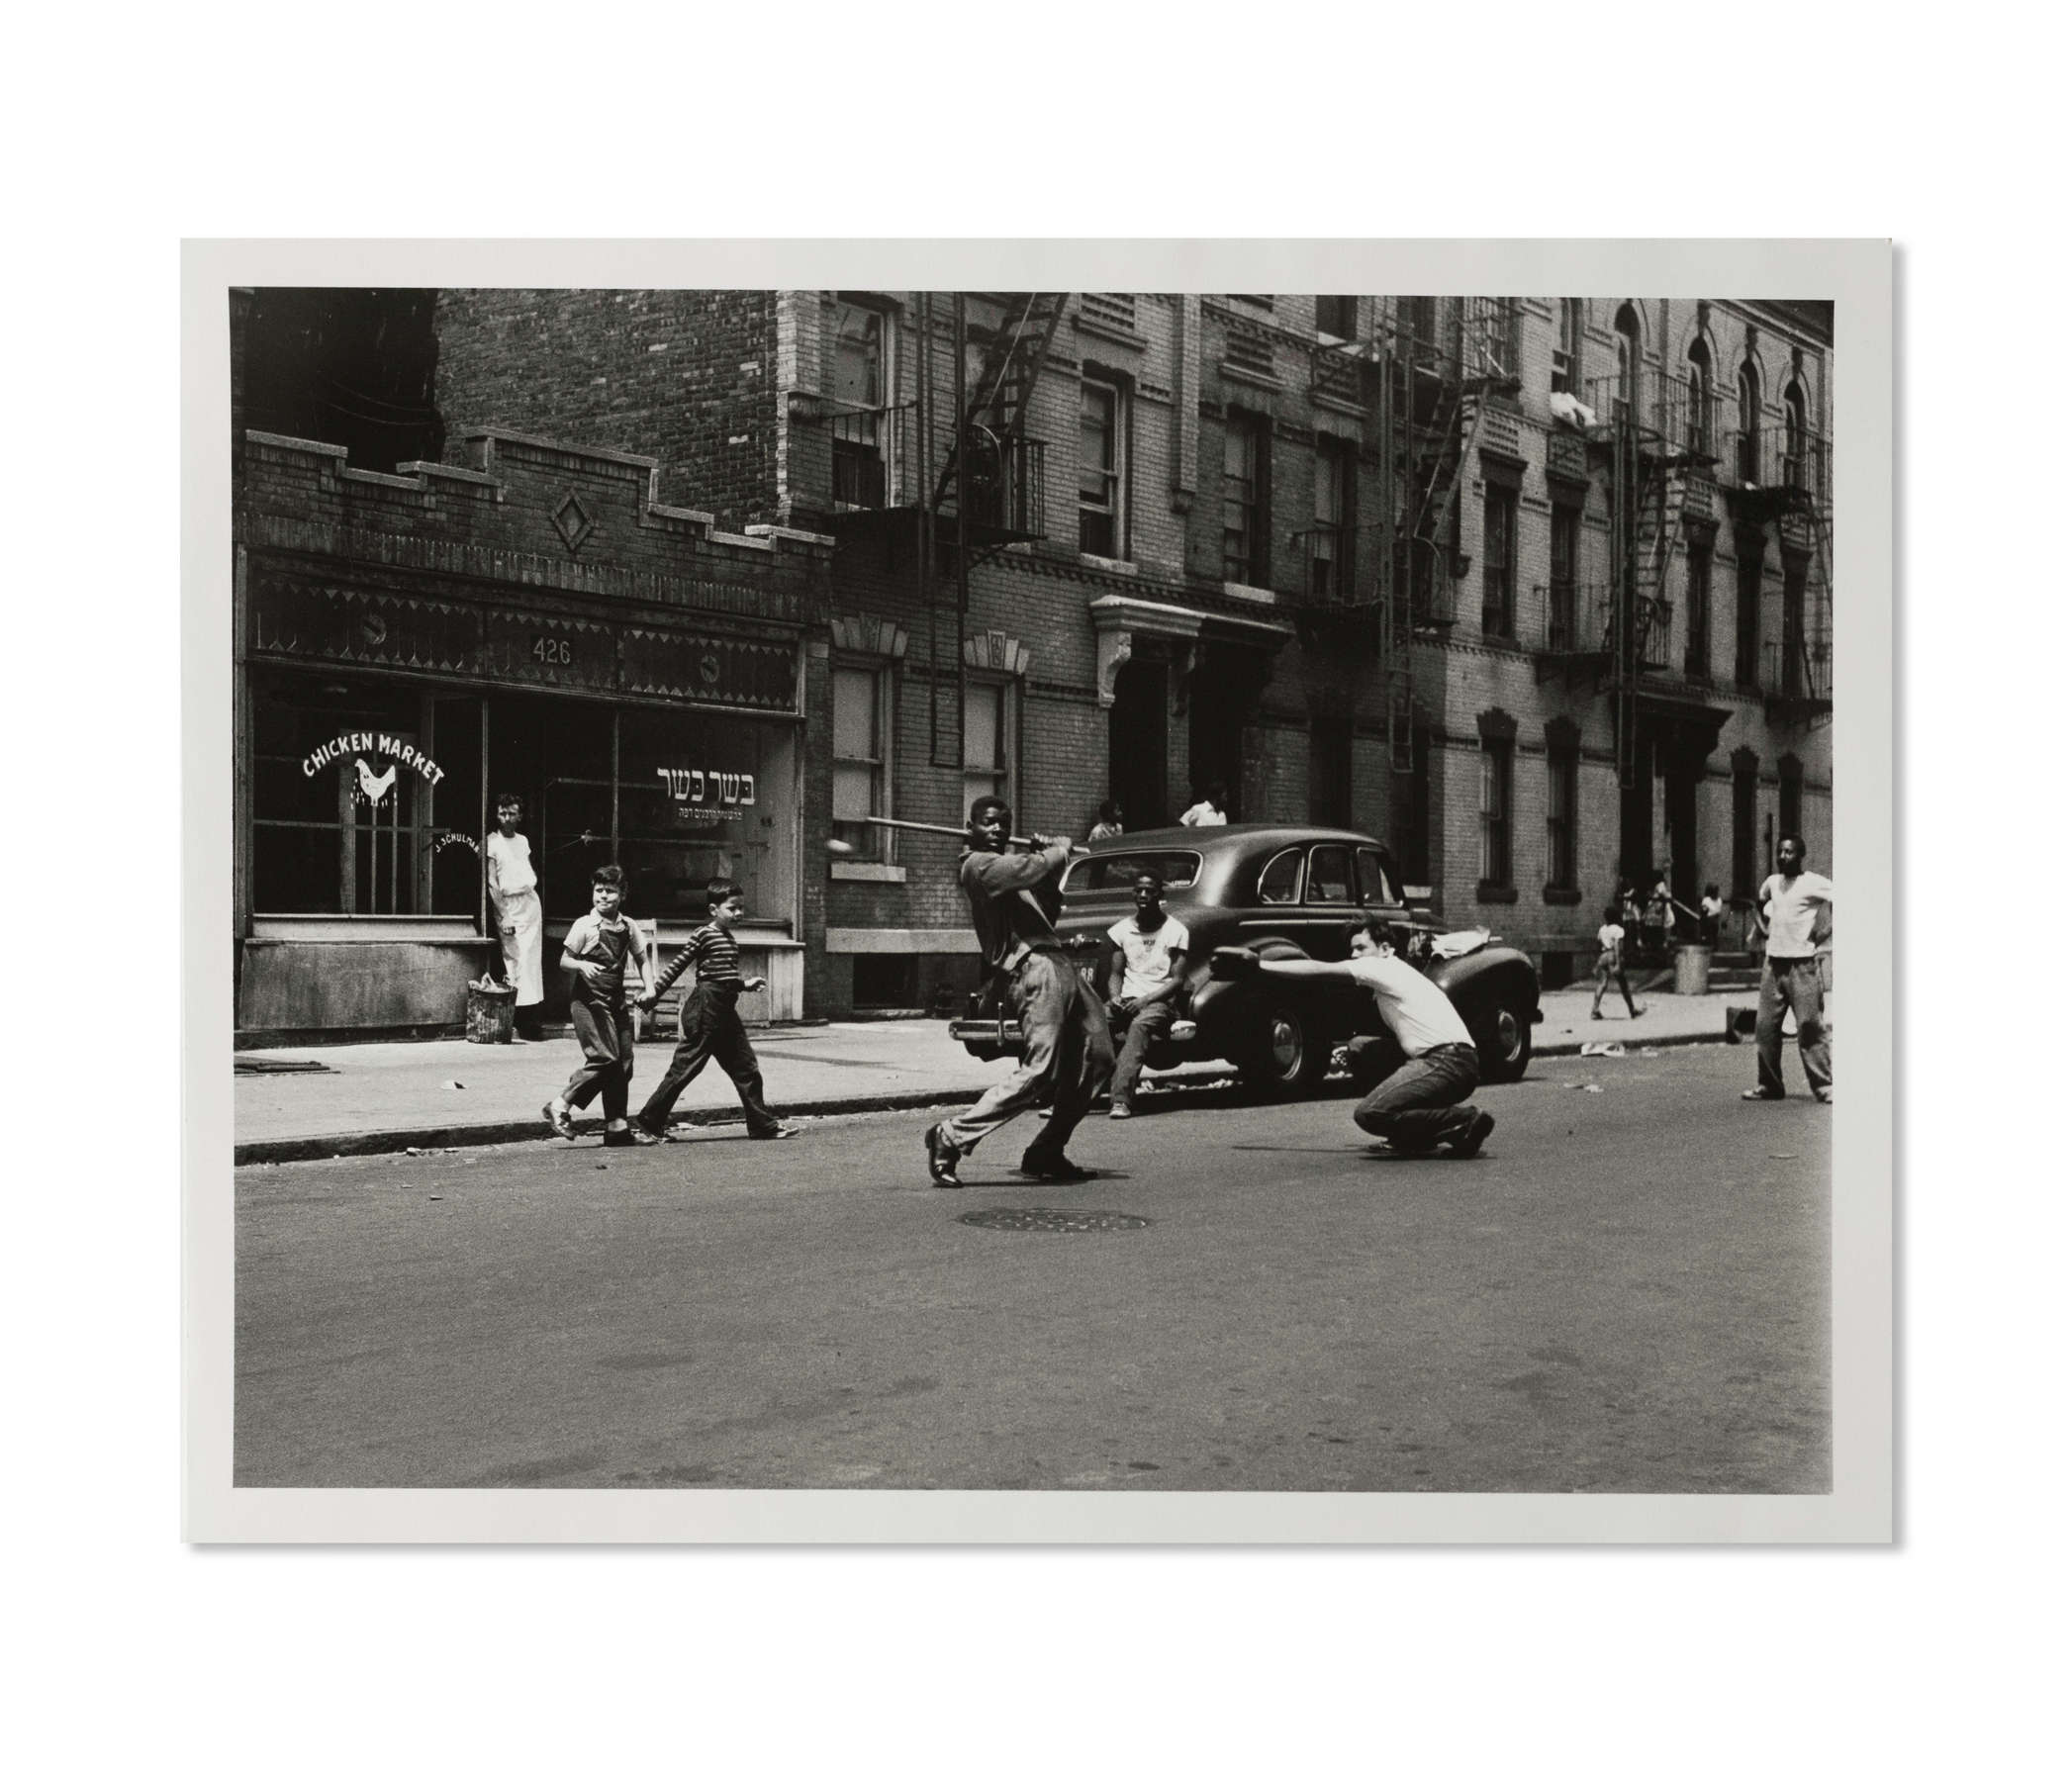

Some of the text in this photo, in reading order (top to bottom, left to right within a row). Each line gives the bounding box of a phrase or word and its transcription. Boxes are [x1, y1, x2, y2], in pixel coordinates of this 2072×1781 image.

[532, 636, 571, 665] 426
[303, 732, 445, 786] CHICKEN MARKET
